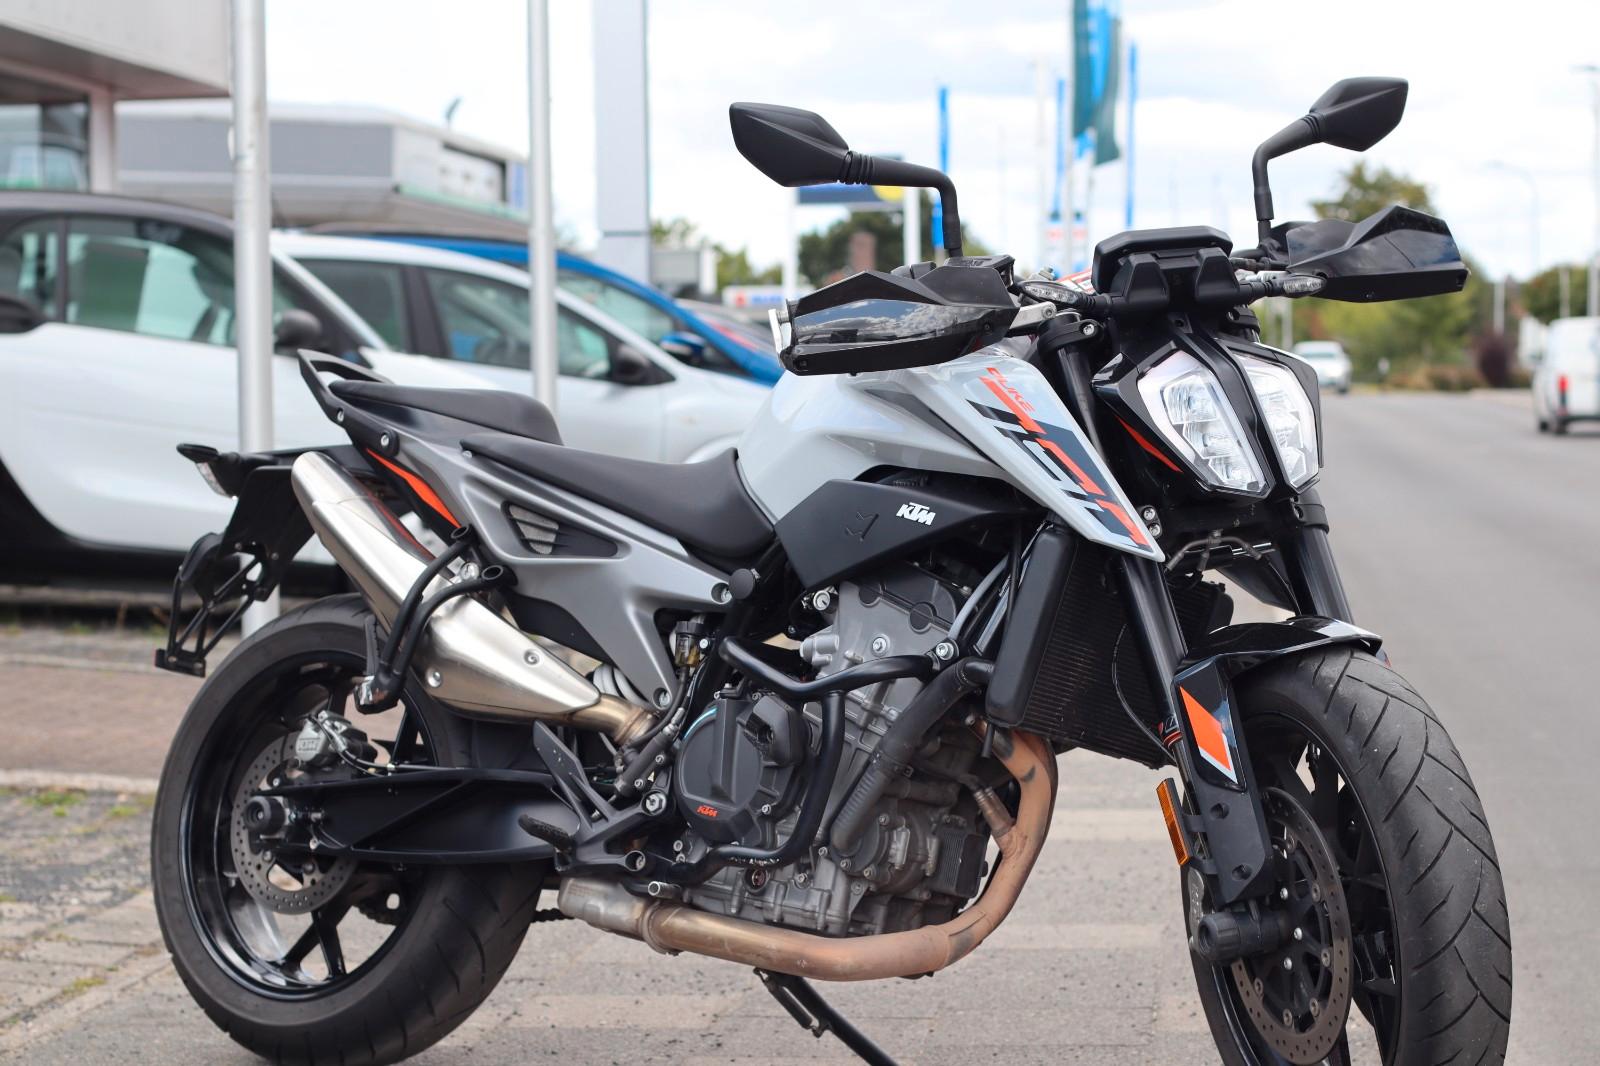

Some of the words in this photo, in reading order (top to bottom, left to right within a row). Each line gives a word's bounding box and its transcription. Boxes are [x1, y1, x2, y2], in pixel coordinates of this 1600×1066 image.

[986, 367, 1036, 412] DUKE
[896, 501, 936, 526] KTM
[696, 804, 718, 817] KTM
